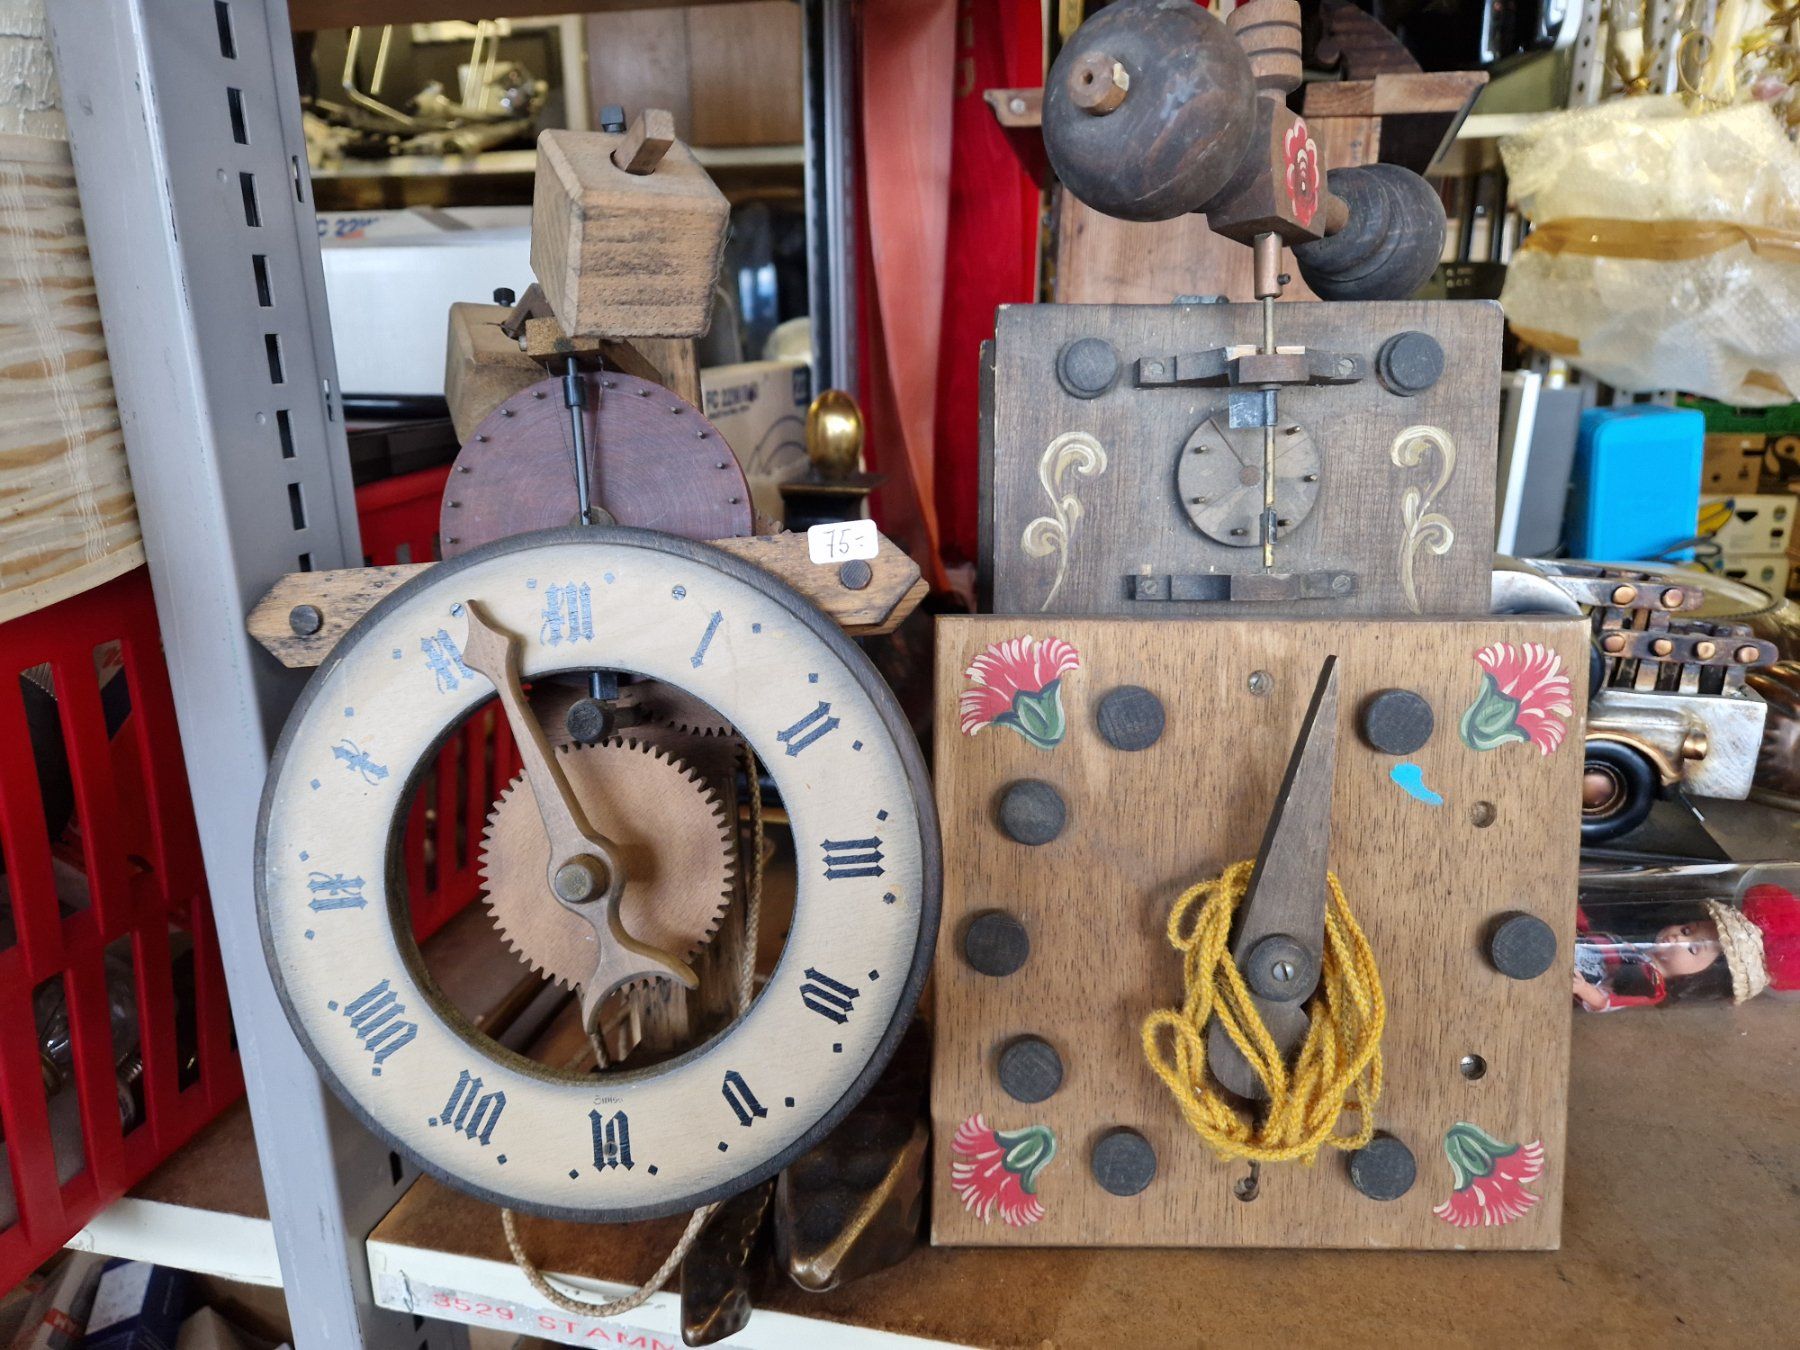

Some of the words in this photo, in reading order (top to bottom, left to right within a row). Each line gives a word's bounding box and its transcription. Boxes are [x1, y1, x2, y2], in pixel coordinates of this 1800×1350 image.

[541, 581, 595, 647] XII
[691, 610, 724, 669] I
[777, 701, 841, 757] II
[331, 738, 390, 786] X
[820, 835, 885, 880] III
[432, 1292, 514, 1321] 3529
